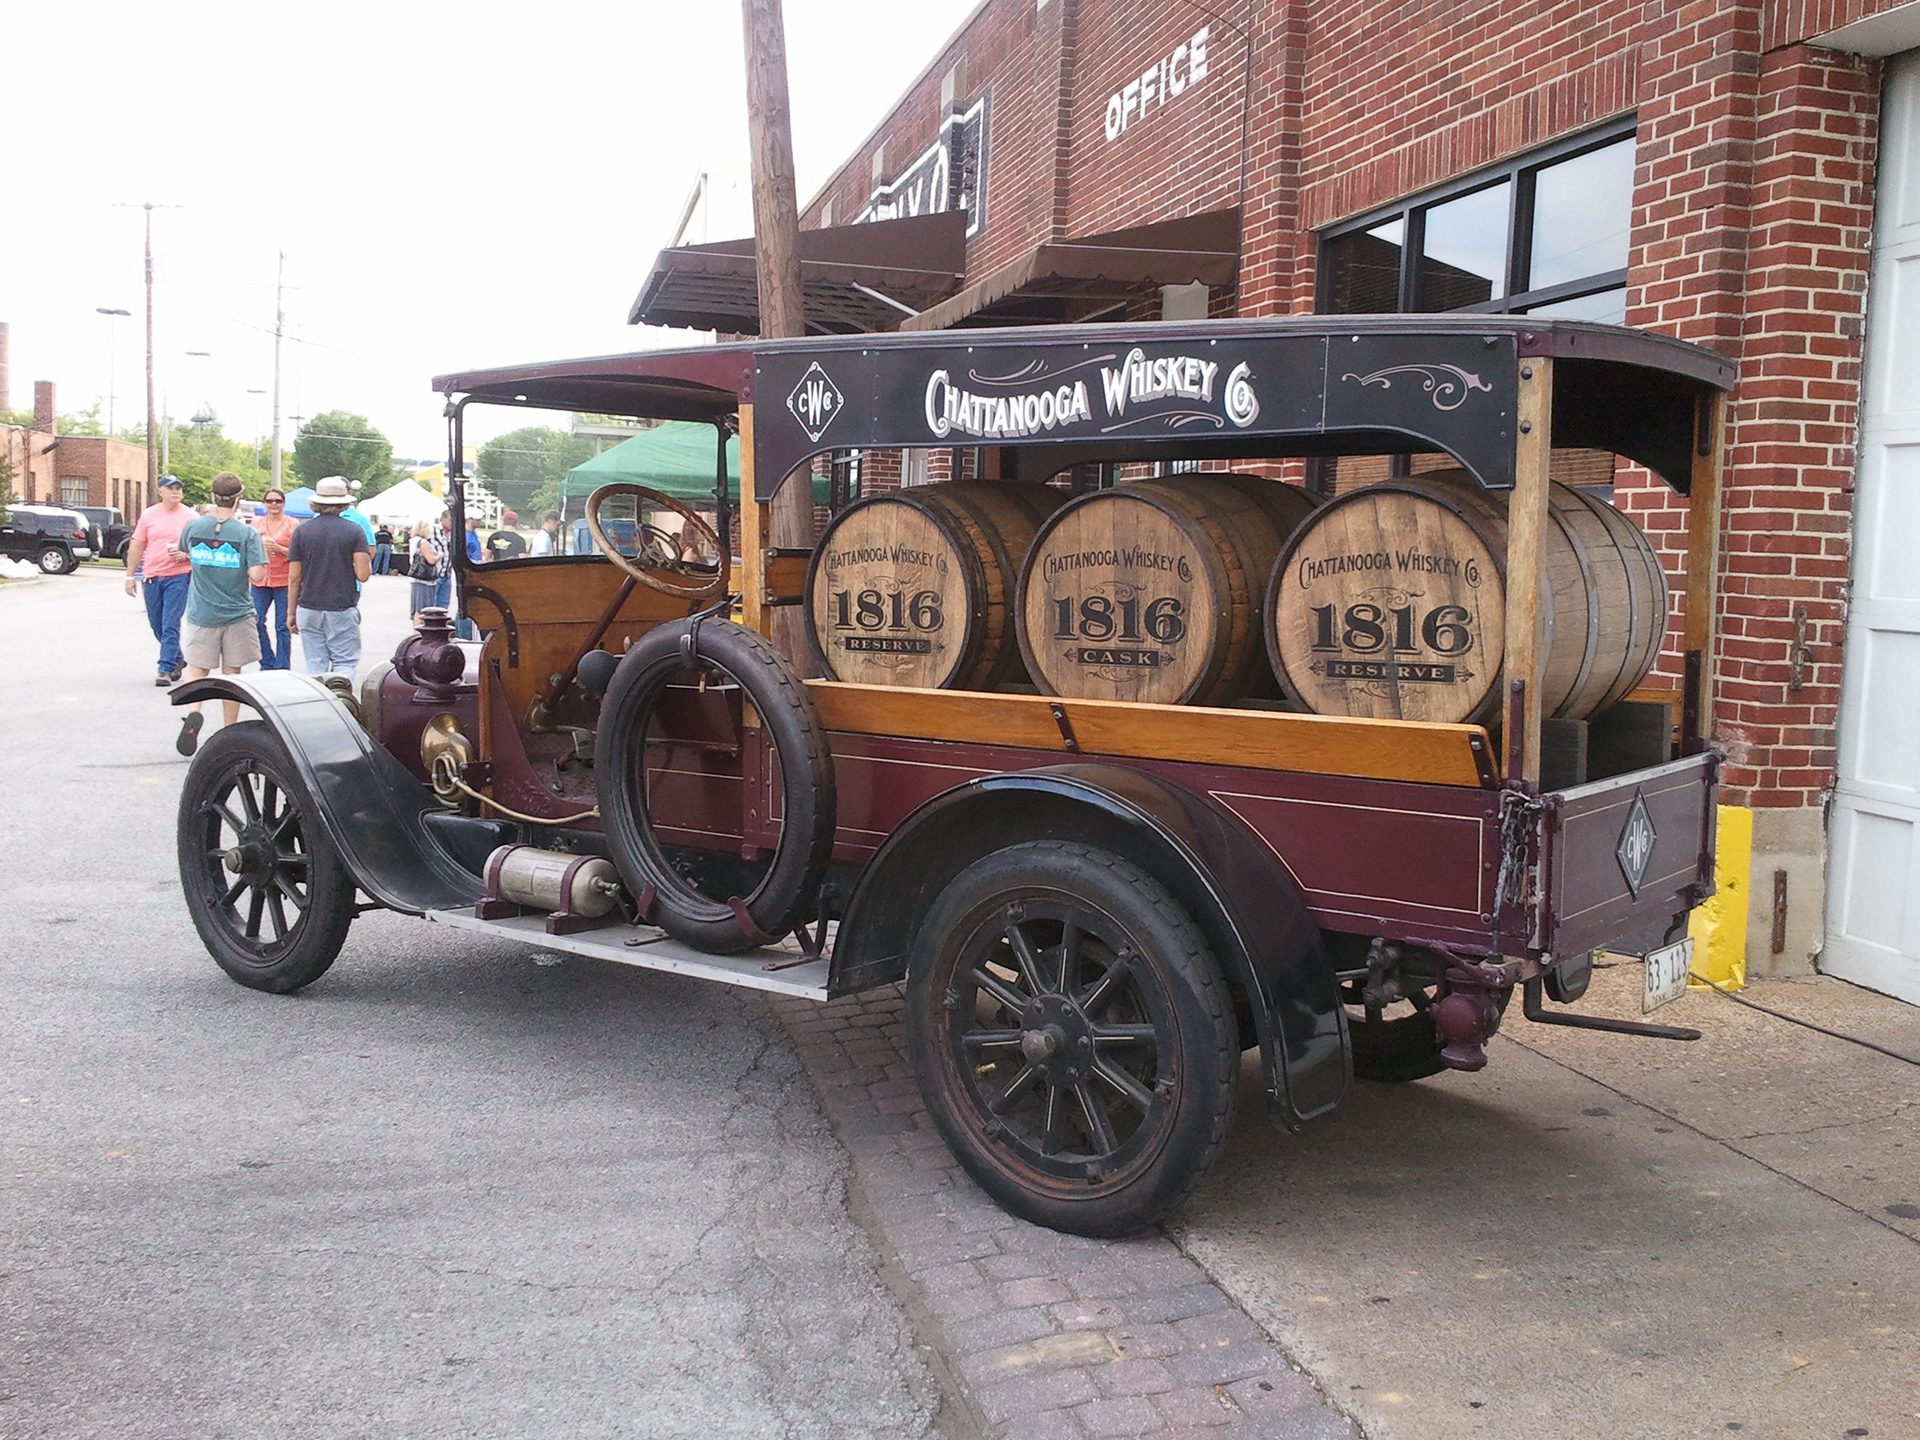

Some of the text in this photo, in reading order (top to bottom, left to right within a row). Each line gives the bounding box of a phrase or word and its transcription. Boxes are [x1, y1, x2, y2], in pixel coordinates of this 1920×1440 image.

[1105, 27, 1209, 141] OFFICE
[925, 369, 1090, 437] CHATTANOOGA
[1101, 348, 1217, 417] WHISKEY
[825, 547, 888, 578] CHATTANOOGA
[890, 542, 934, 568] WHISKEY
[1043, 549, 1120, 583] CHATTANOOGA
[1122, 544, 1175, 573] WHISKEY
[1300, 552, 1392, 589] CHATTANOOGA
[1396, 546, 1461, 577] WHISKEY
[833, 589, 944, 633] 1816
[1052, 595, 1187, 645] 1816
[1310, 603, 1474, 657] 1816
[849, 638, 926, 652] RESERVE
[1083, 651, 1152, 664] CASK
